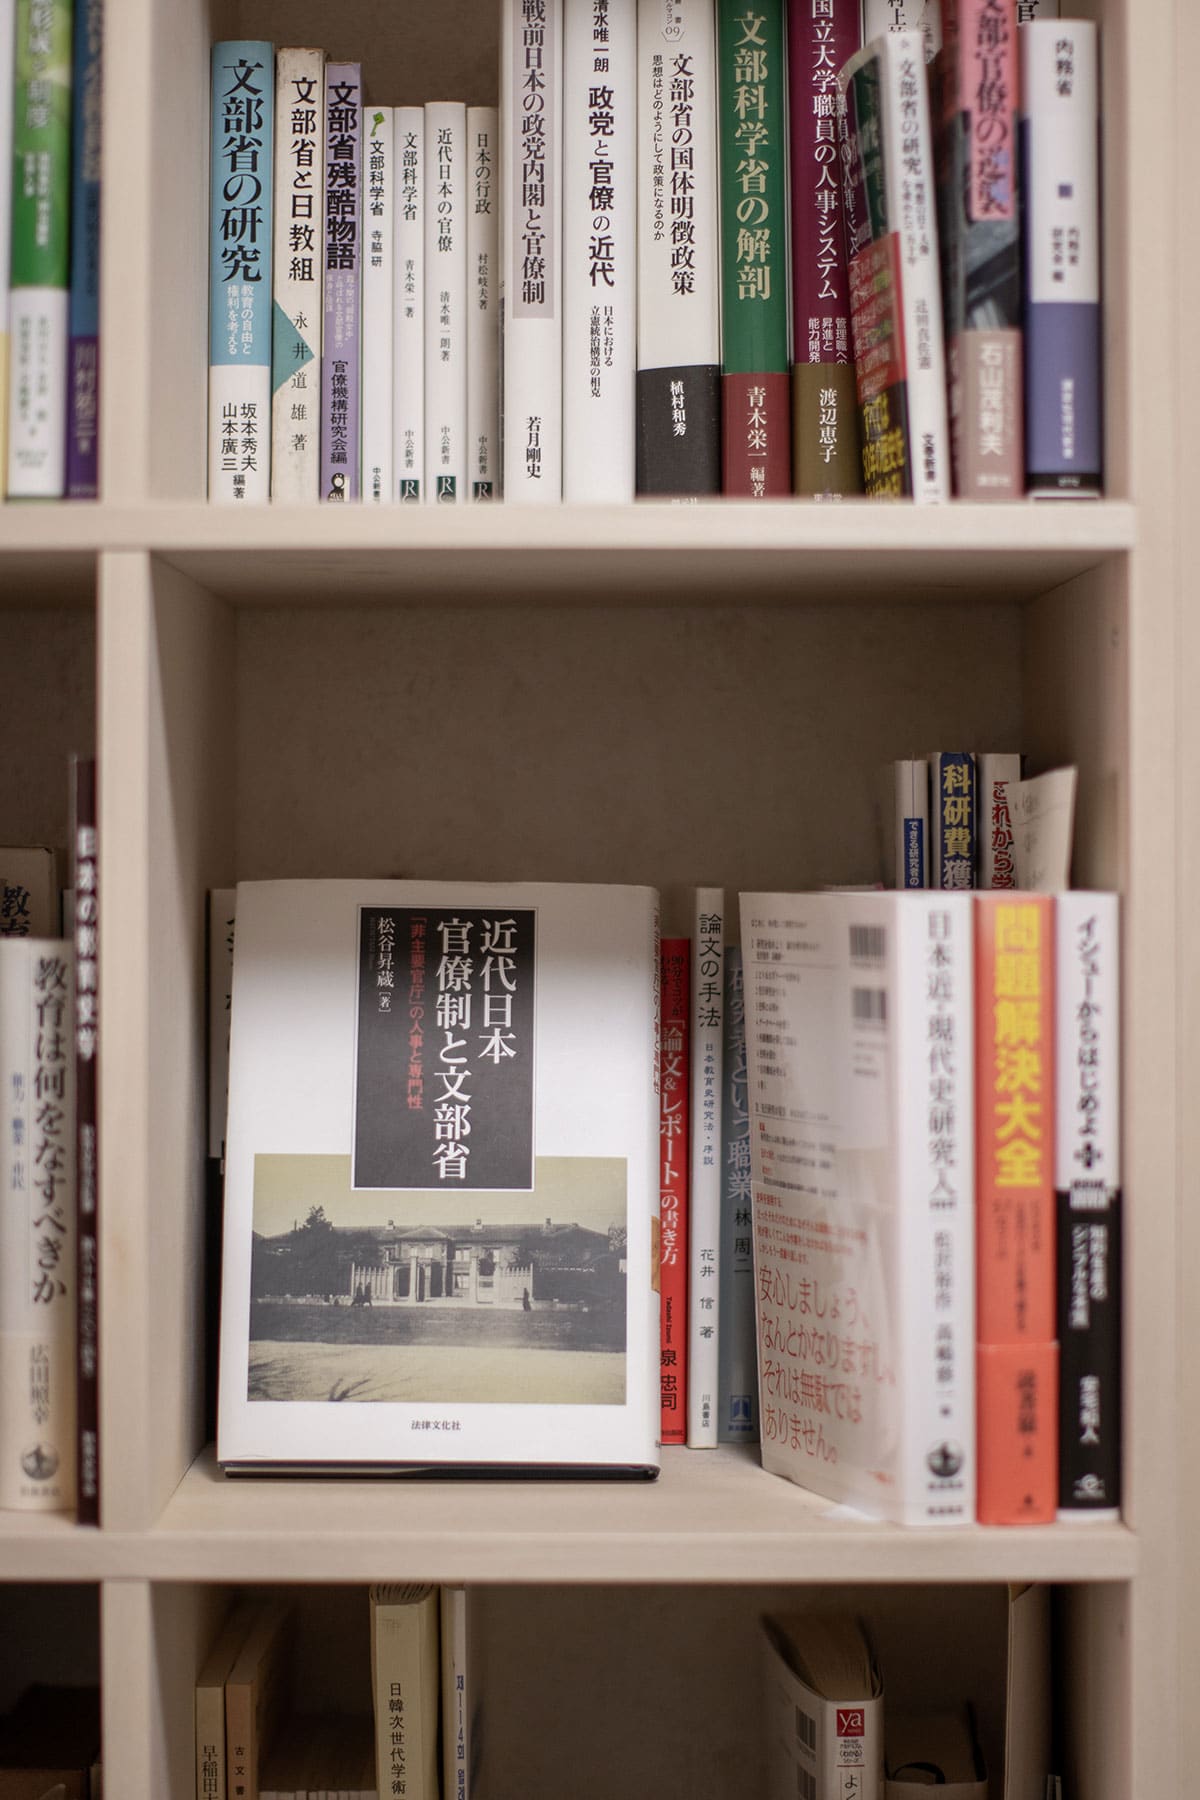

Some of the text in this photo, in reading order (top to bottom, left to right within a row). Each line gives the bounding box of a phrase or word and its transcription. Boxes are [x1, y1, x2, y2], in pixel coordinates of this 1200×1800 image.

[219, 59, 264, 283] 文部省の研究
[288, 76, 318, 282] 文部省と日教組
[326, 81, 359, 271] 文部省残酷物語
[369, 140, 385, 216] 文部科学省
[402, 132, 418, 221] 文部科学省
[475, 133, 491, 215] 日本の行政
[521, 0, 546, 305] 戦前日本の政党内閣と官僚制
[588, 85, 615, 287] 政党と官僚の近代
[652, 54, 665, 241] 思想はどのようにして政策になるのか
[669, 53, 695, 296] 文部省の国体明徴政策
[733, 10, 771, 301] 文部科学省の解剖
[811, 0, 839, 300] 国立大学職員の人事システム
[436, 128, 453, 252] 近代日本の官僚
[370, 230, 383, 267] 寺脇研
[227, 285, 240, 355] 権利を考える
[240, 284, 254, 355] 教育の自由と
[404, 260, 415, 318] 青木栄一著
[440, 291, 451, 362] 清水唯一朗著
[590, 305, 601, 398] 立憲統治構造の相克
[604, 305, 614, 367] 日本における
[808, 317, 821, 365] 能力開発
[822, 317, 833, 351] 昇進と
[291, 312, 308, 451] 永井道雄著
[330, 360, 349, 464] 官僚機構研究会編
[670, 380, 688, 437] 植村和秀
[221, 402, 239, 471] 山本廣三
[240, 402, 258, 472] 坂本秀夫
[405, 429, 415, 469] 中公新書
[441, 426, 451, 465] 中公新書
[479, 435, 488, 475] 中公新書
[525, 416, 541, 479] 若月剛史
[747, 386, 767, 457] 青木栄一
[233, 474, 245, 499] 編著
[909, 821, 920, 886] できる研究者の
[477, 917, 518, 1065] 近代日本
[698, 913, 722, 1028] 論文の手法
[431, 917, 474, 1180] 官僚制と文部省
[993, 904, 1043, 1188] 問題解決大全
[34, 957, 67, 1304] 教育は何をなすべきか
[411, 1419, 461, 1431] 法律文化社
